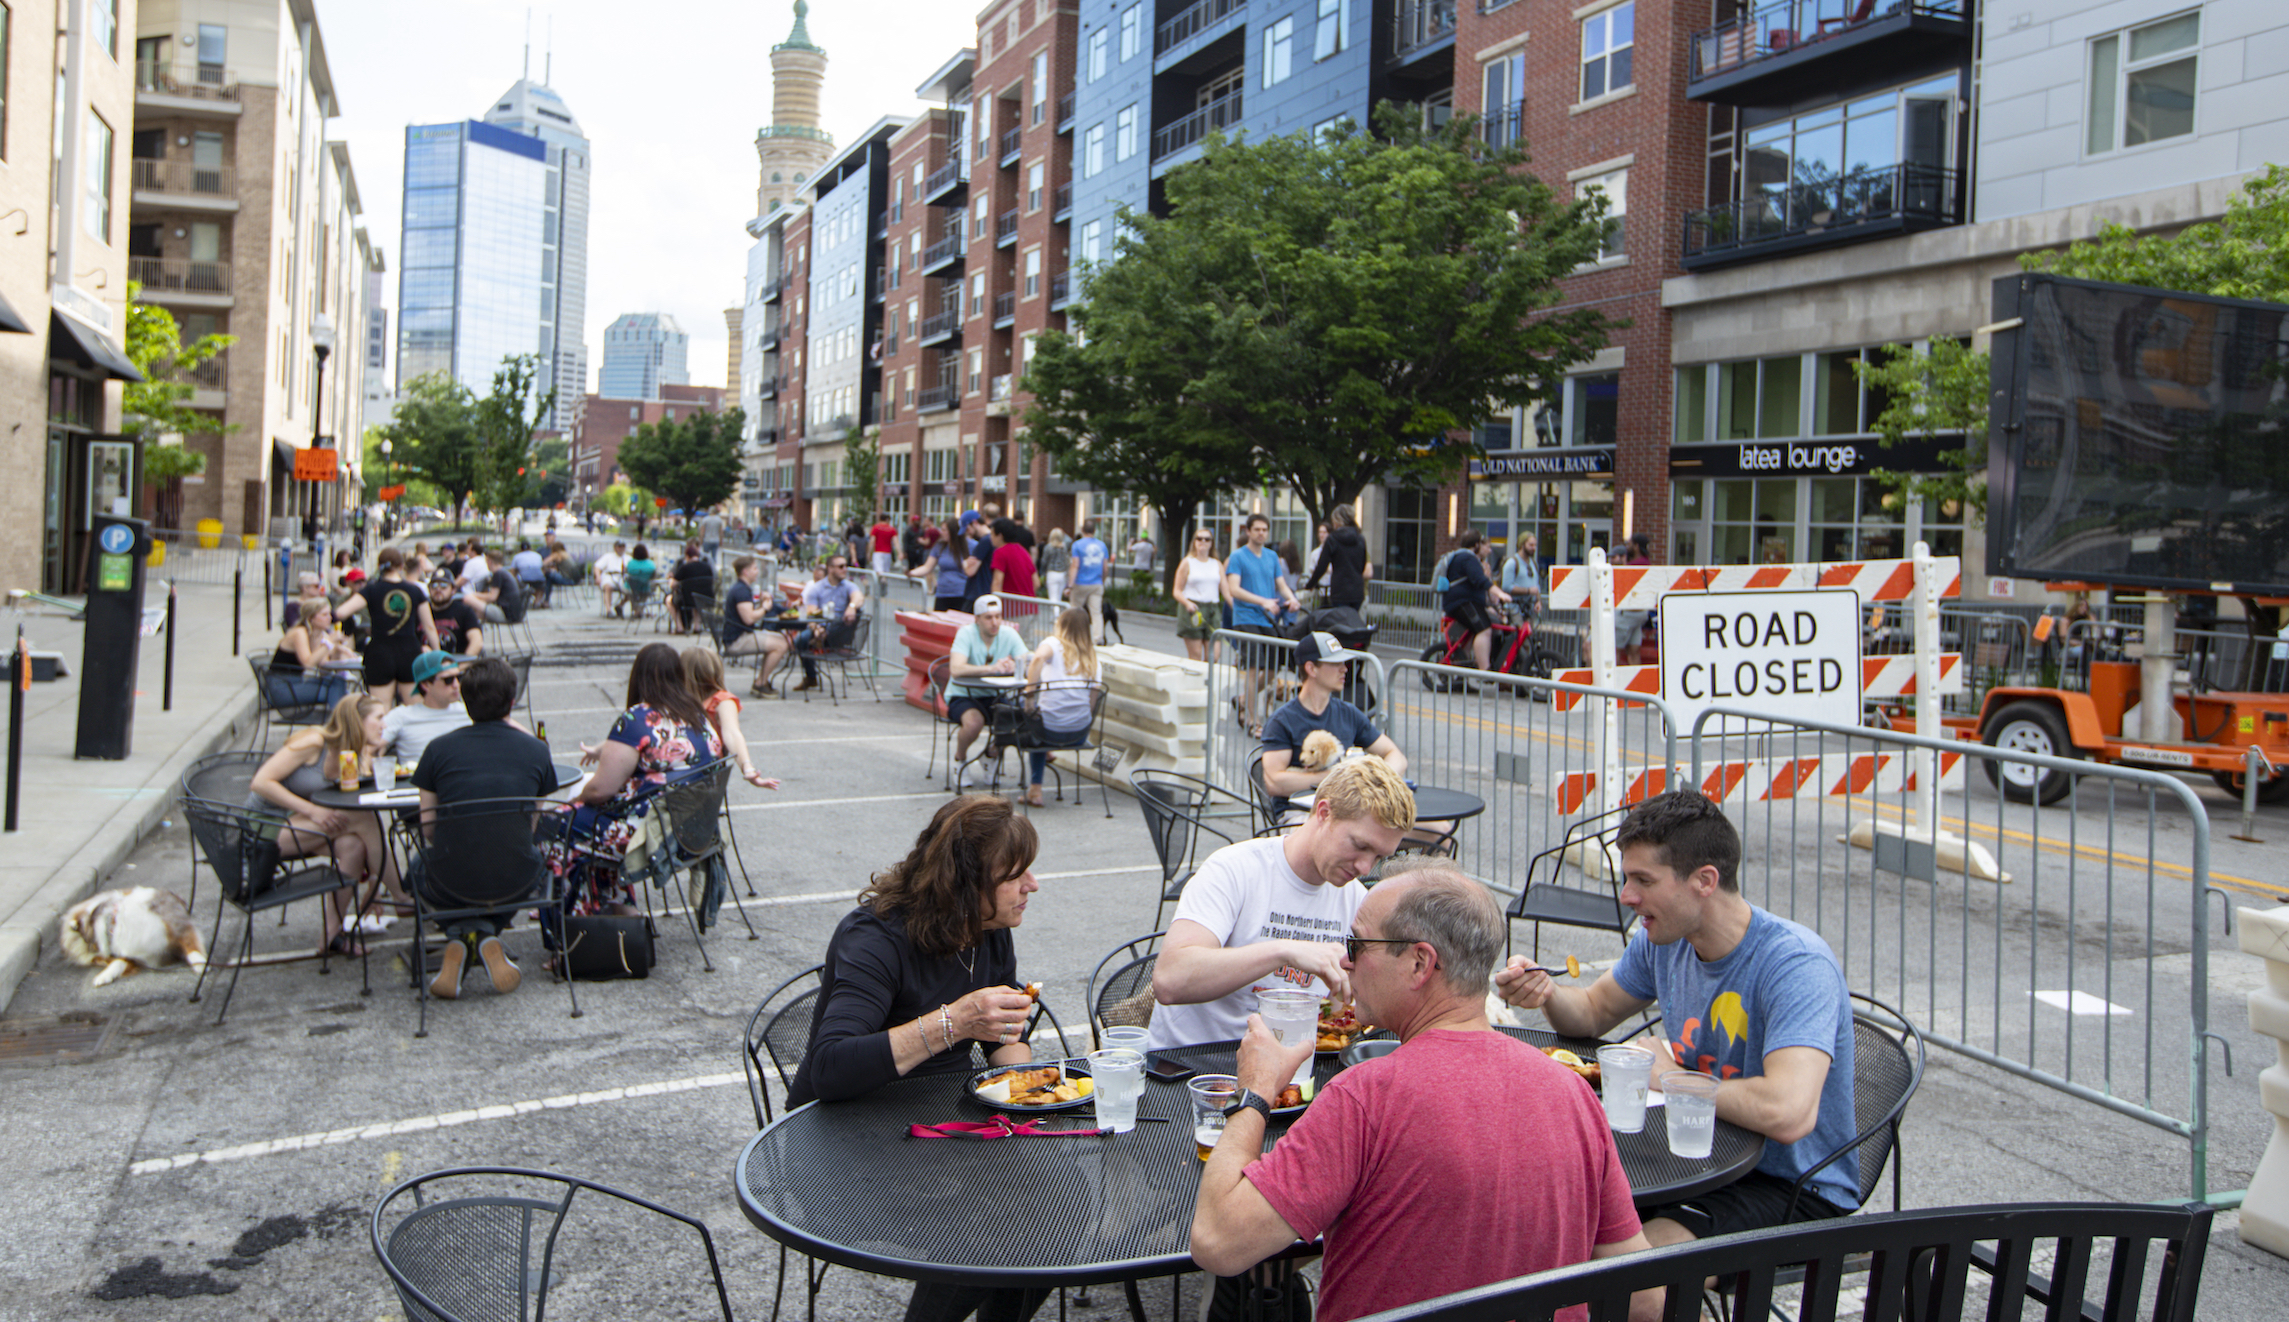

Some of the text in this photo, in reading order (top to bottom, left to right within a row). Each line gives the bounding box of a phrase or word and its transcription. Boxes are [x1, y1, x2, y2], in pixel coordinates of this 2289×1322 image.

[1507, 456, 1563, 474] NATIONAL
[1564, 456, 1599, 473] BANK
[1739, 442, 1856, 474] latea lounge
[111, 528, 127, 549] P
[383, 589, 412, 636] 9
[1704, 611, 1817, 649] ROAD
[1681, 658, 1843, 699] CLOSED
[1269, 911, 1285, 925] Ohio
[1286, 914, 1313, 929] Northern
[1682, 1115, 1711, 1125] HARP
